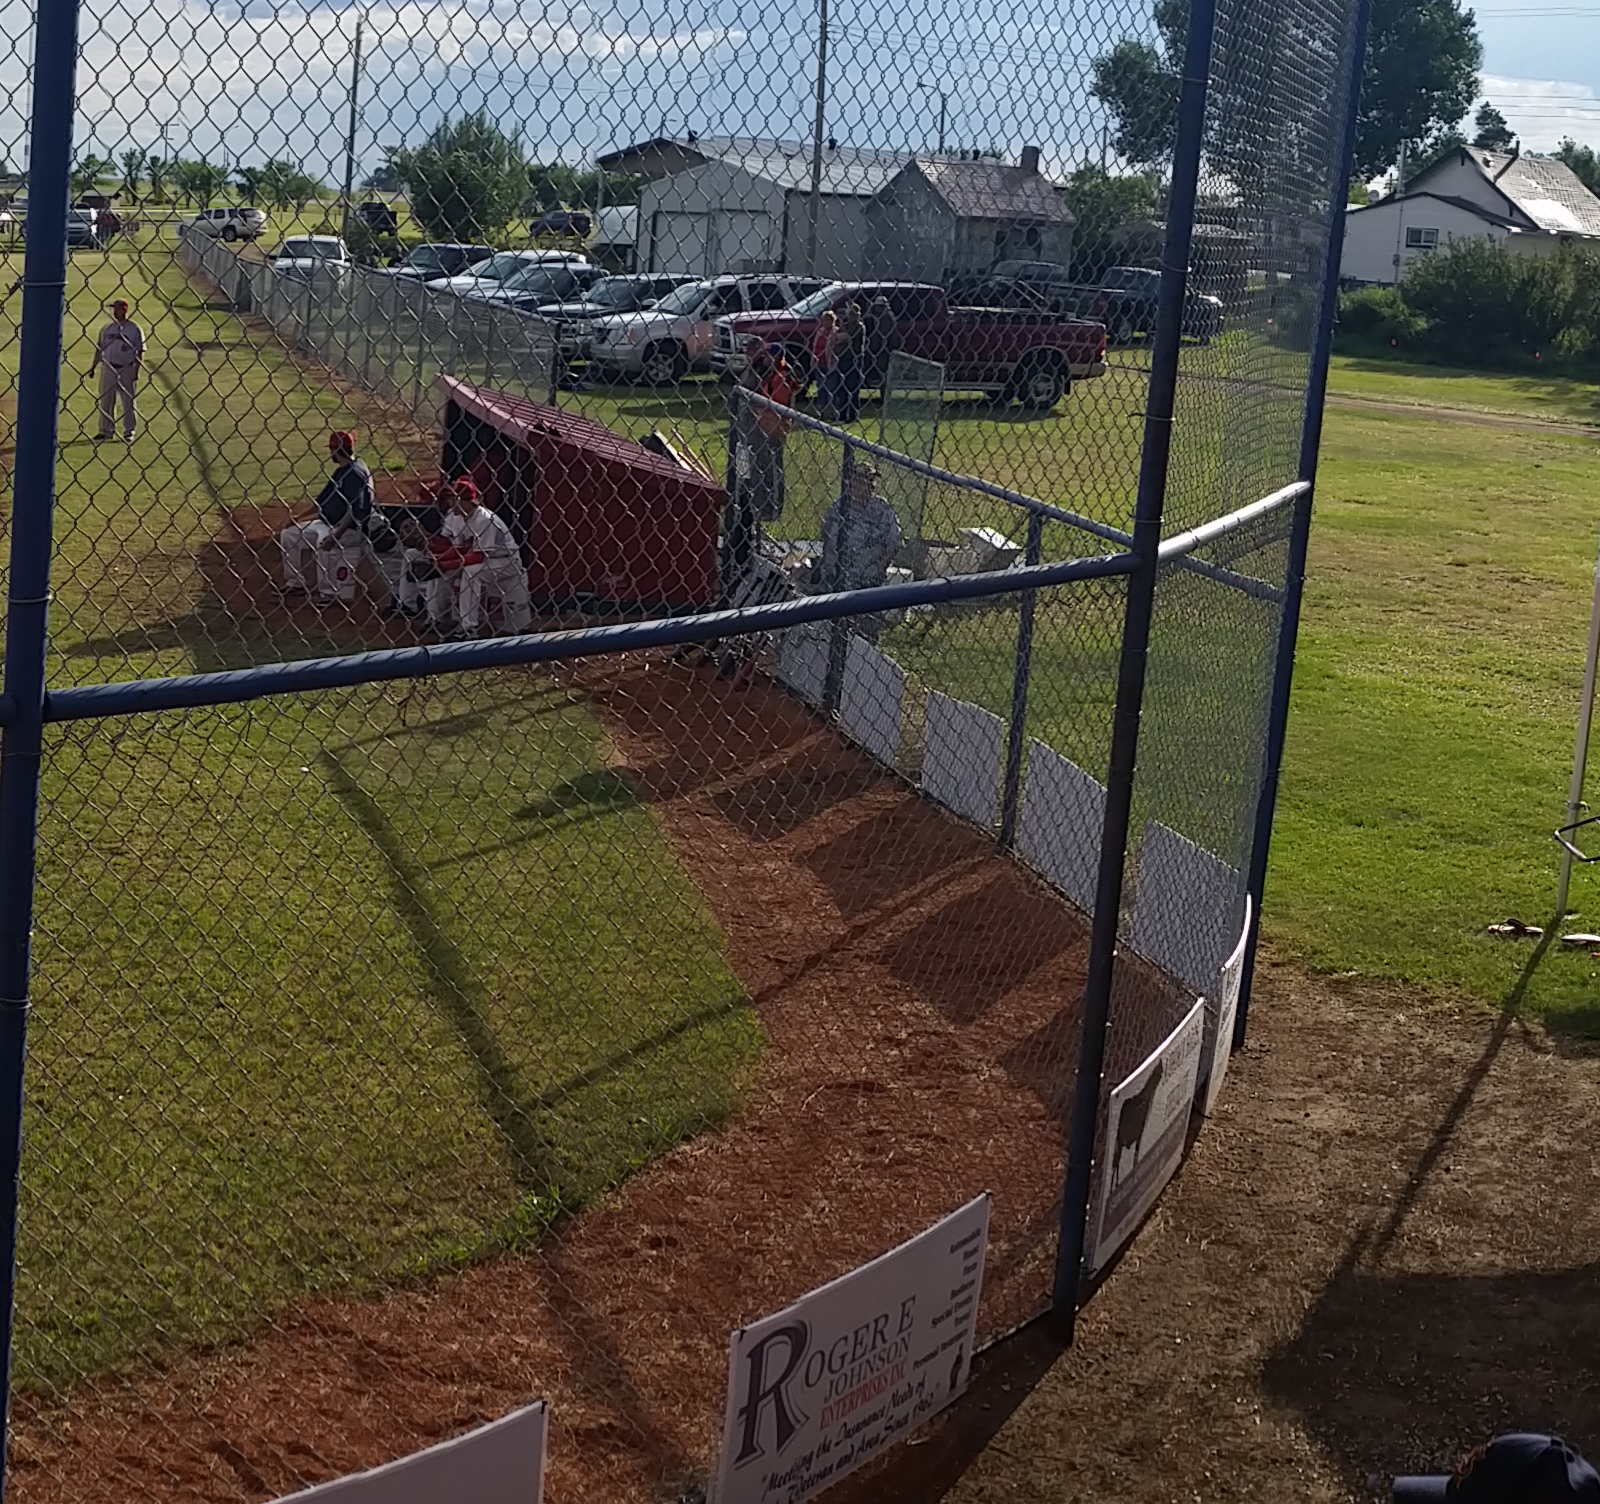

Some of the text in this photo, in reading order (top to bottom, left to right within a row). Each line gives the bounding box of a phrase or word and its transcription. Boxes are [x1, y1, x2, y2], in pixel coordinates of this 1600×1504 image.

[734, 1295, 916, 1470] ROGER E
[819, 1357, 907, 1431] ENTERPRISES INC
[823, 1333, 912, 1404] JOHNSON
